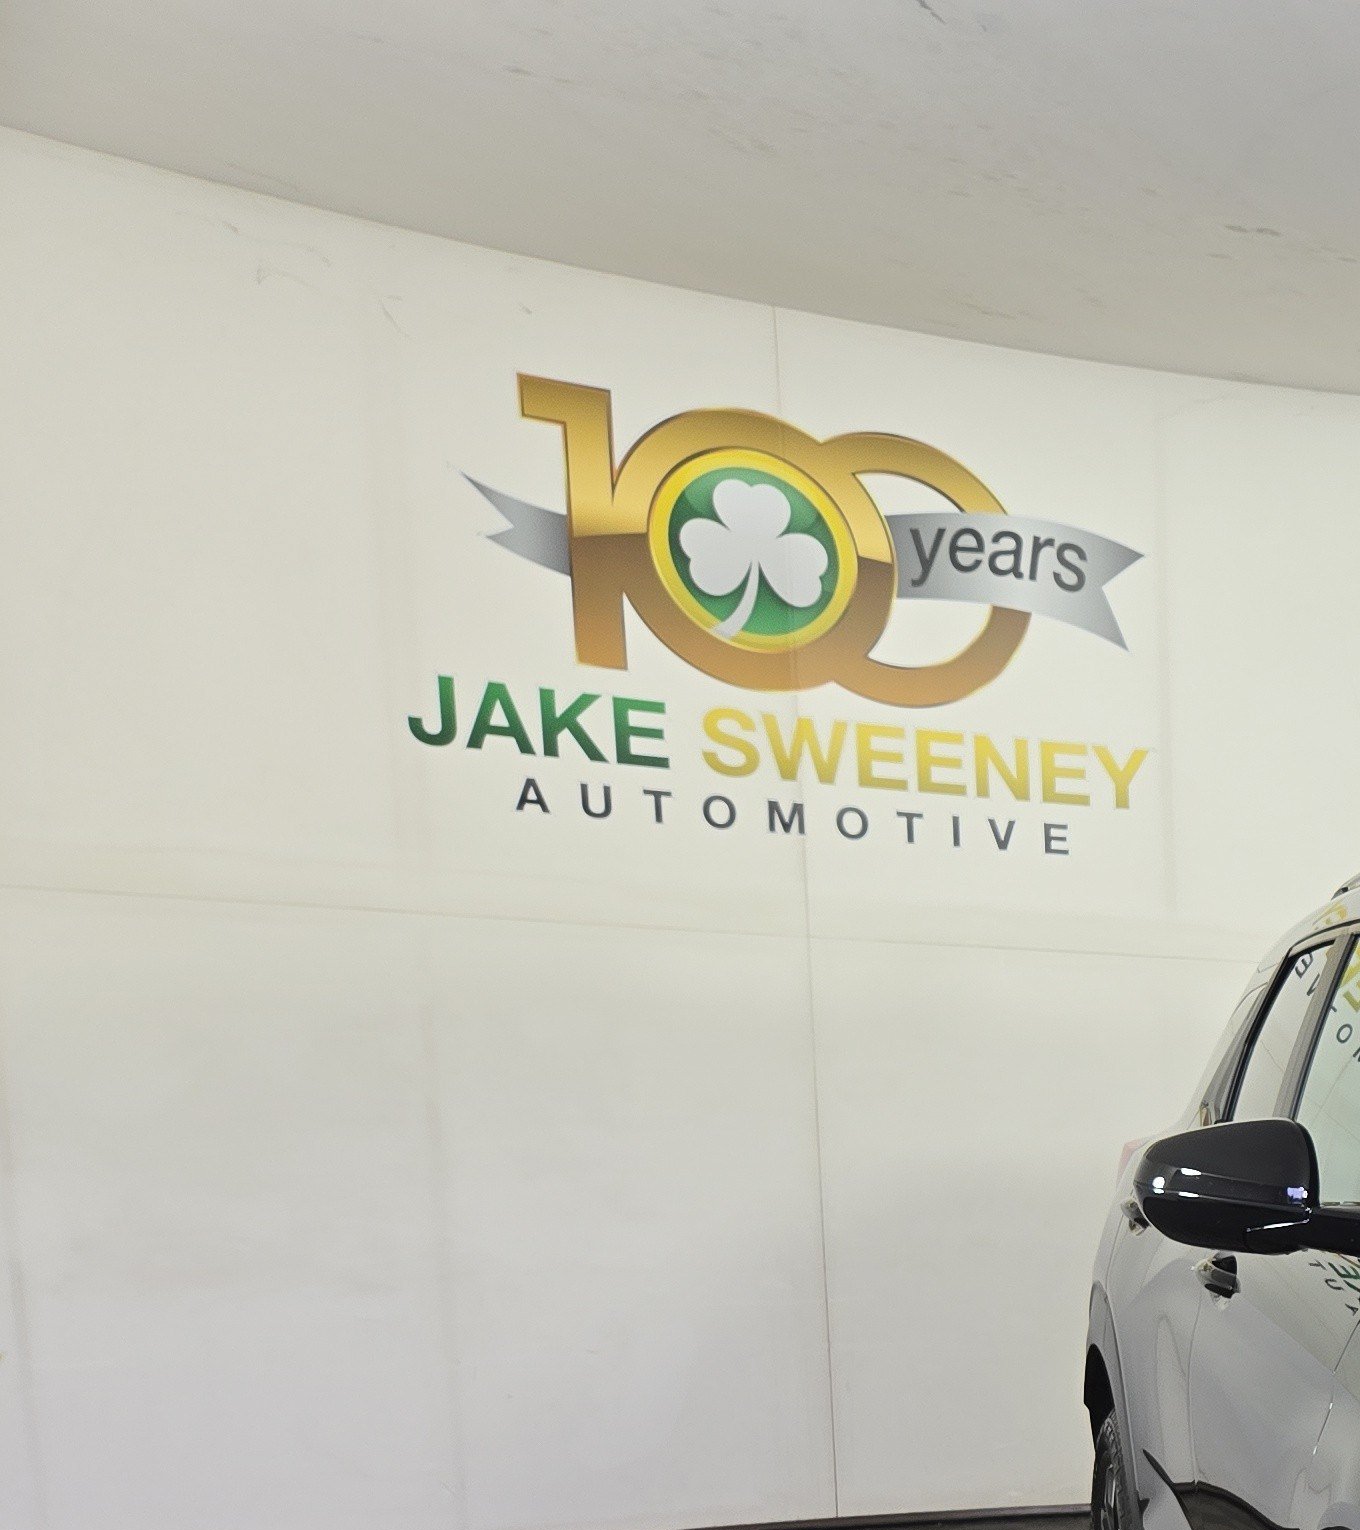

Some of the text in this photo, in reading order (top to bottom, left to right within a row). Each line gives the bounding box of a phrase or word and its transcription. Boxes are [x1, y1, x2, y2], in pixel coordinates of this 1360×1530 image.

[515, 371, 1032, 708] 100
[906, 522, 1089, 592] years
[407, 674, 1149, 810] JAKE SWEENEY
[516, 777, 1072, 856] AUTOMOTIVE
